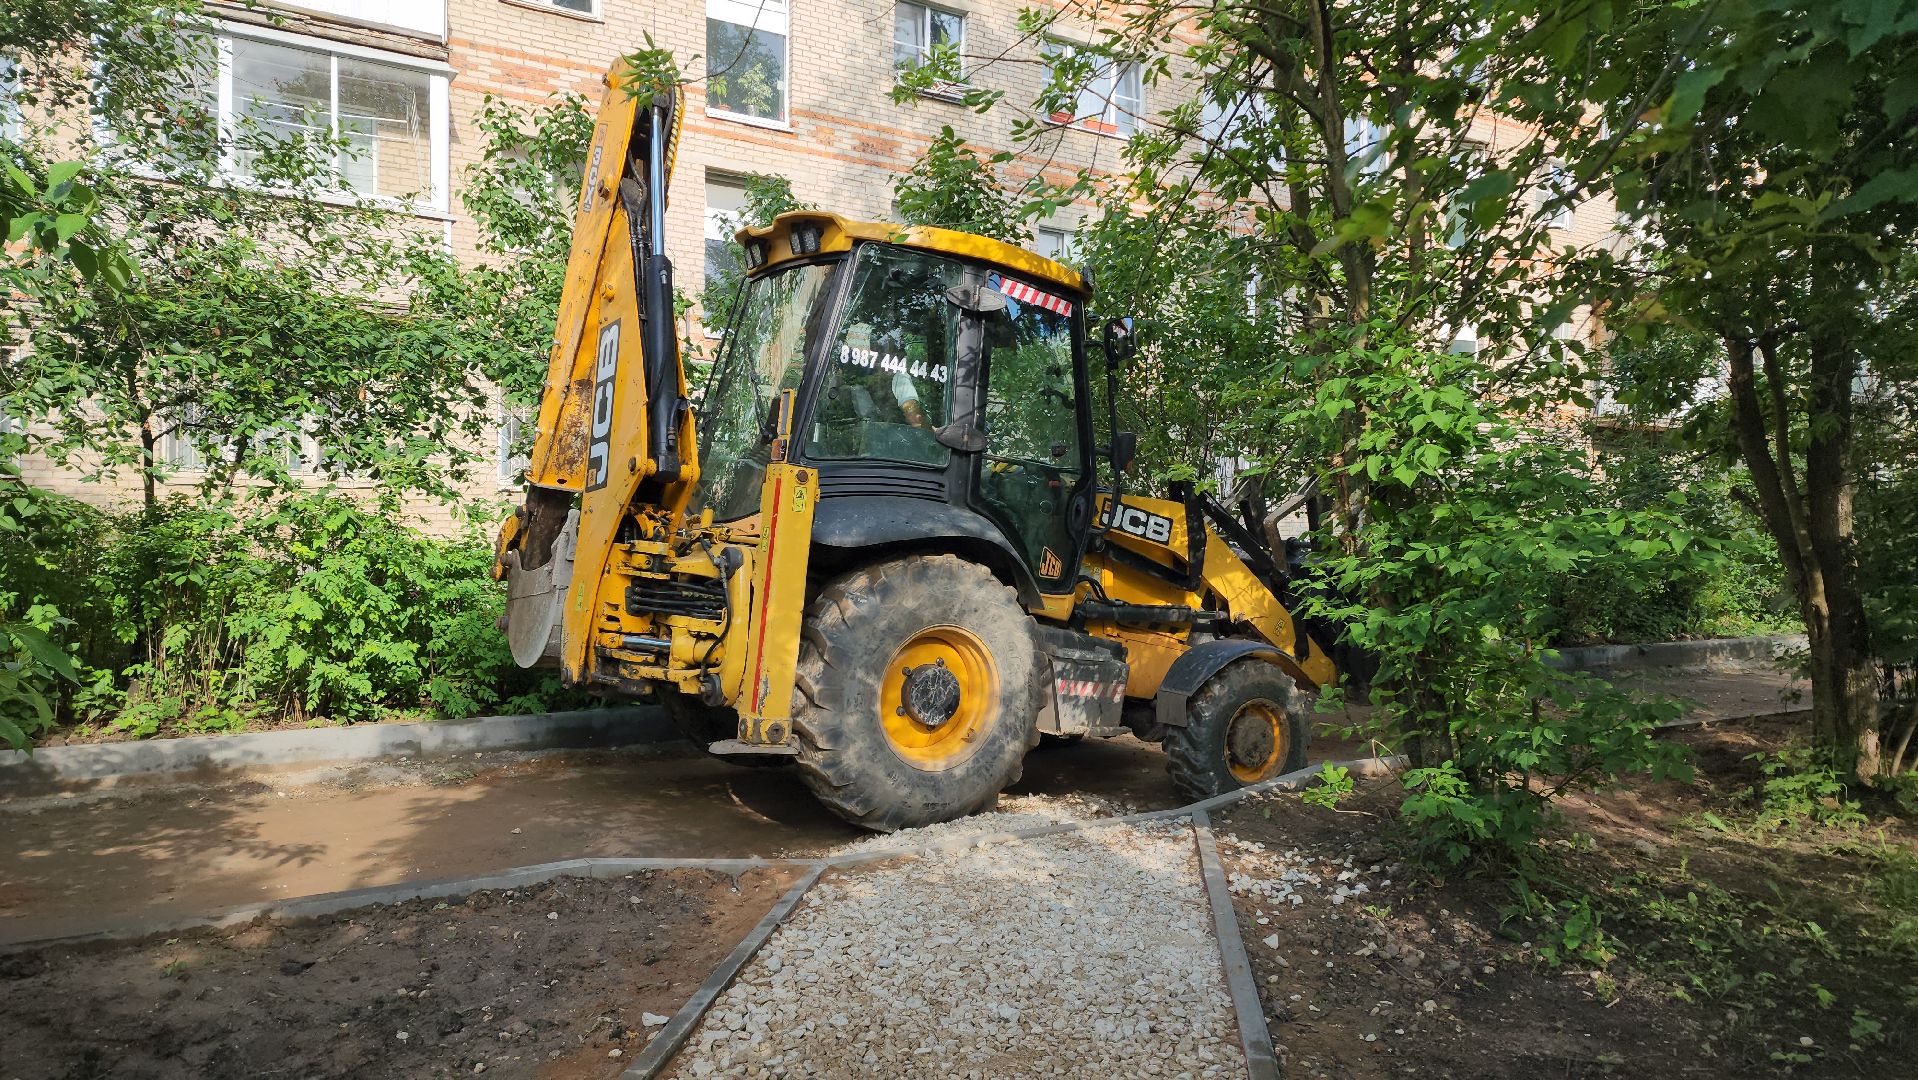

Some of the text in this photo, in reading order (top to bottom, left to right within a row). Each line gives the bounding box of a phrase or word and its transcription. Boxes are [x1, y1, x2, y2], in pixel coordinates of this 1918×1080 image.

[840, 345, 948, 383] 8 987 444 44 43
[591, 324, 619, 485] JCB
[1101, 504, 1171, 542] JCB
[1041, 551, 1060, 576] JCB
